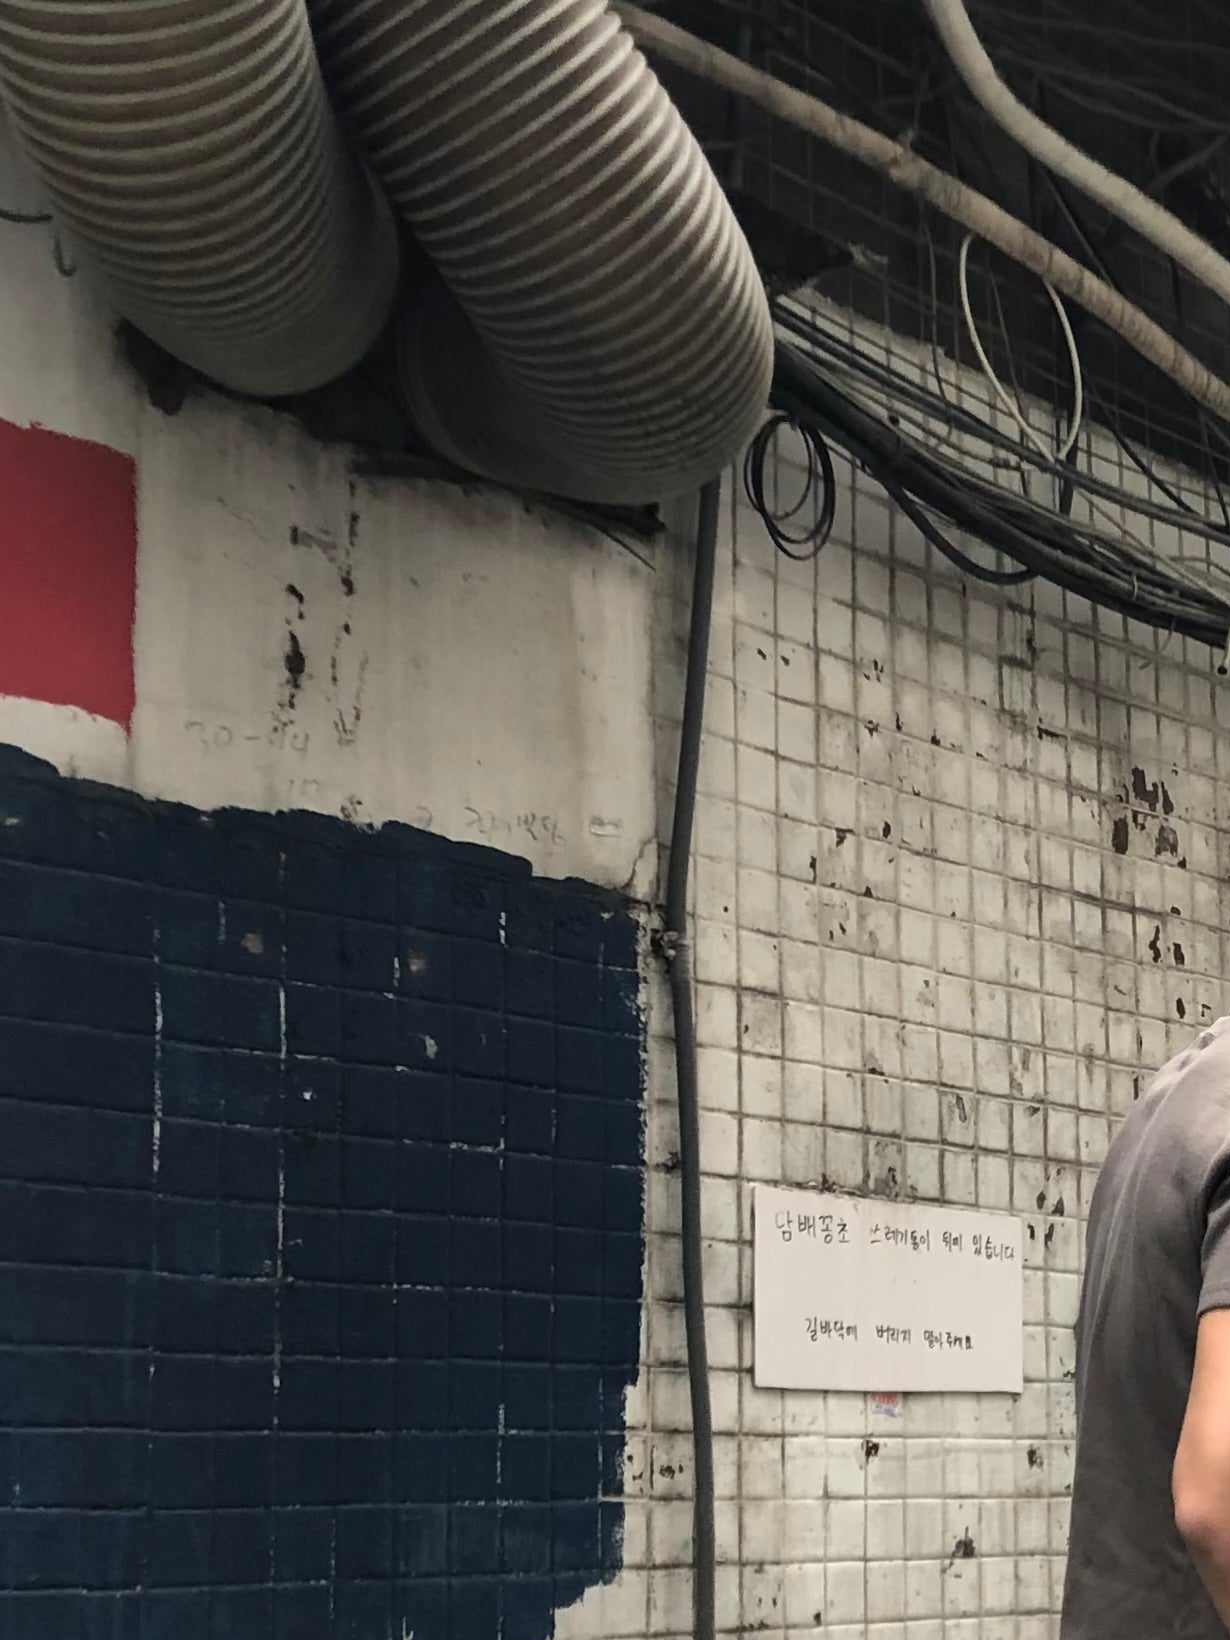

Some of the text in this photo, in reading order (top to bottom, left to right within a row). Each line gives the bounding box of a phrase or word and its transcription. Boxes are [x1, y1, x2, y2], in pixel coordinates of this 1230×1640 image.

[775, 1210, 1015, 1262] 담배꽁초 쓰레기통이 뒤에 있습니다
[804, 1316, 858, 1343] 길바닥에
[875, 1325, 912, 1345] 버리지
